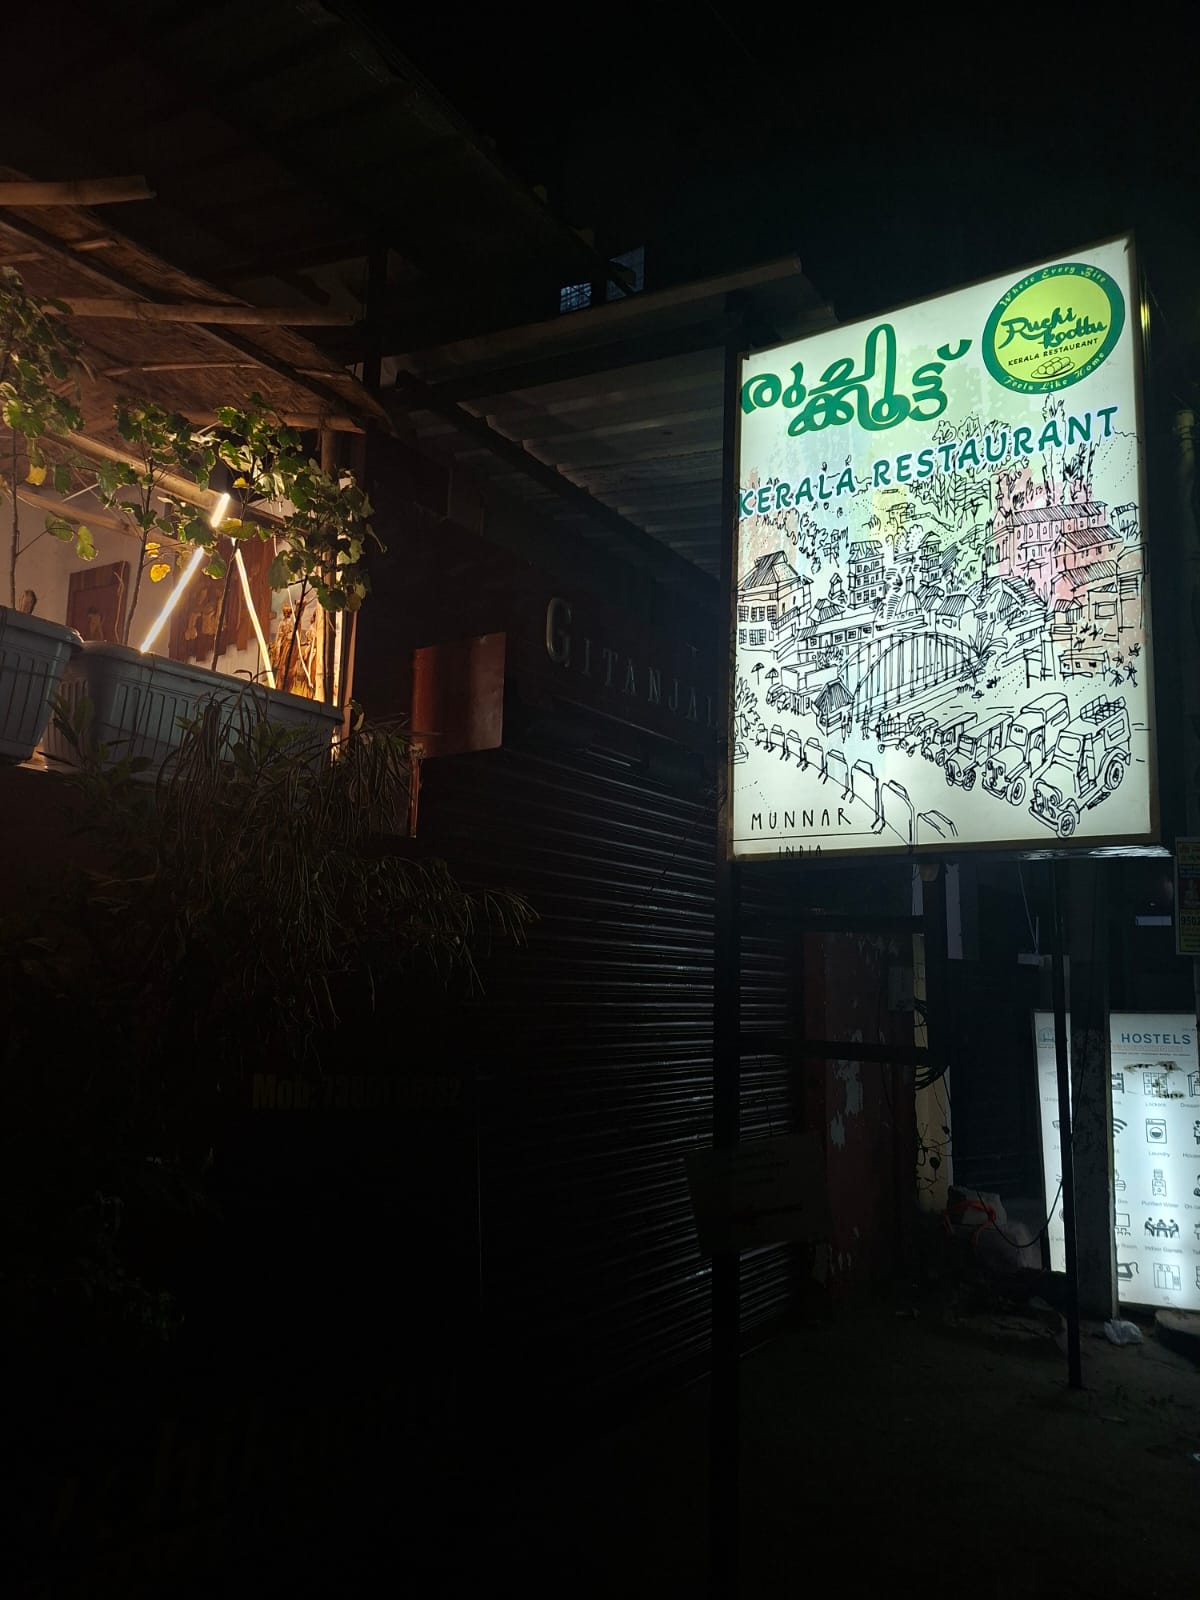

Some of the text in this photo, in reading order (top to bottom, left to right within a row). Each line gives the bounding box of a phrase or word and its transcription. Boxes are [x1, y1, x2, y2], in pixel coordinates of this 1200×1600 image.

[1041, 265, 1076, 279] Every
[998, 307, 1077, 349] Ruchi
[1008, 337, 1099, 366] KERALA RESTAURANT
[739, 406, 1119, 518] KERALA RESTAURANT
[751, 807, 851, 831] MUNNAR
[1121, 1033, 1192, 1046] HOSTELS
